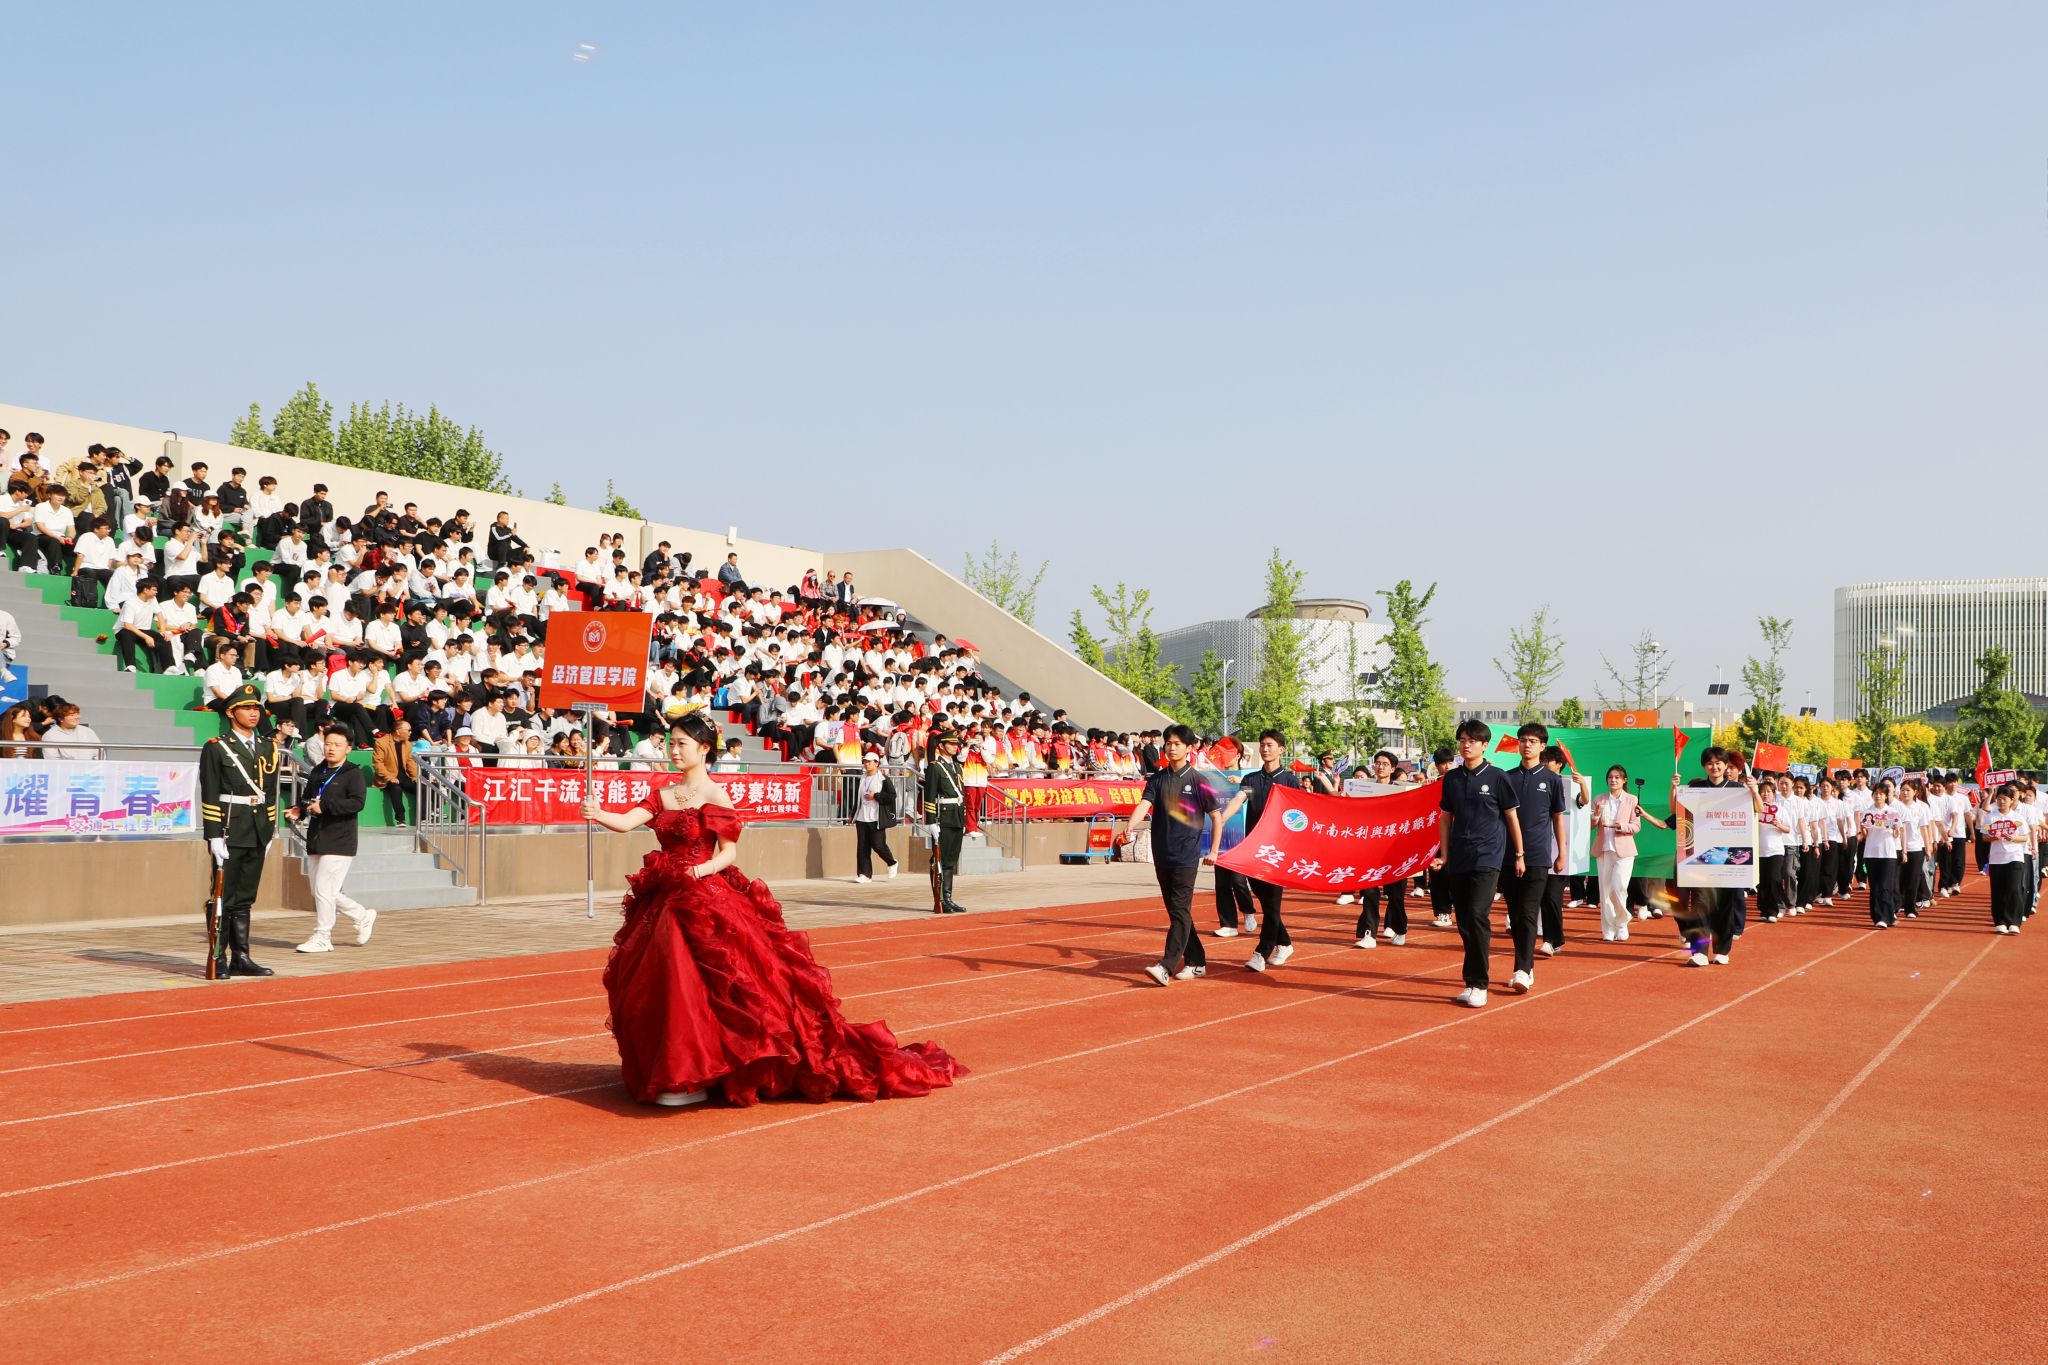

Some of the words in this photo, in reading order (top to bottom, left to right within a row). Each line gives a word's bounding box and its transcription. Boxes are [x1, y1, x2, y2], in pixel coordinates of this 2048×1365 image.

[551, 664, 638, 687] 经济管理学院
[4, 773, 161, 817] 耀青春
[718, 781, 802, 804] 梦赛场新
[1311, 807, 1442, 840] 河南水利與環境職業
